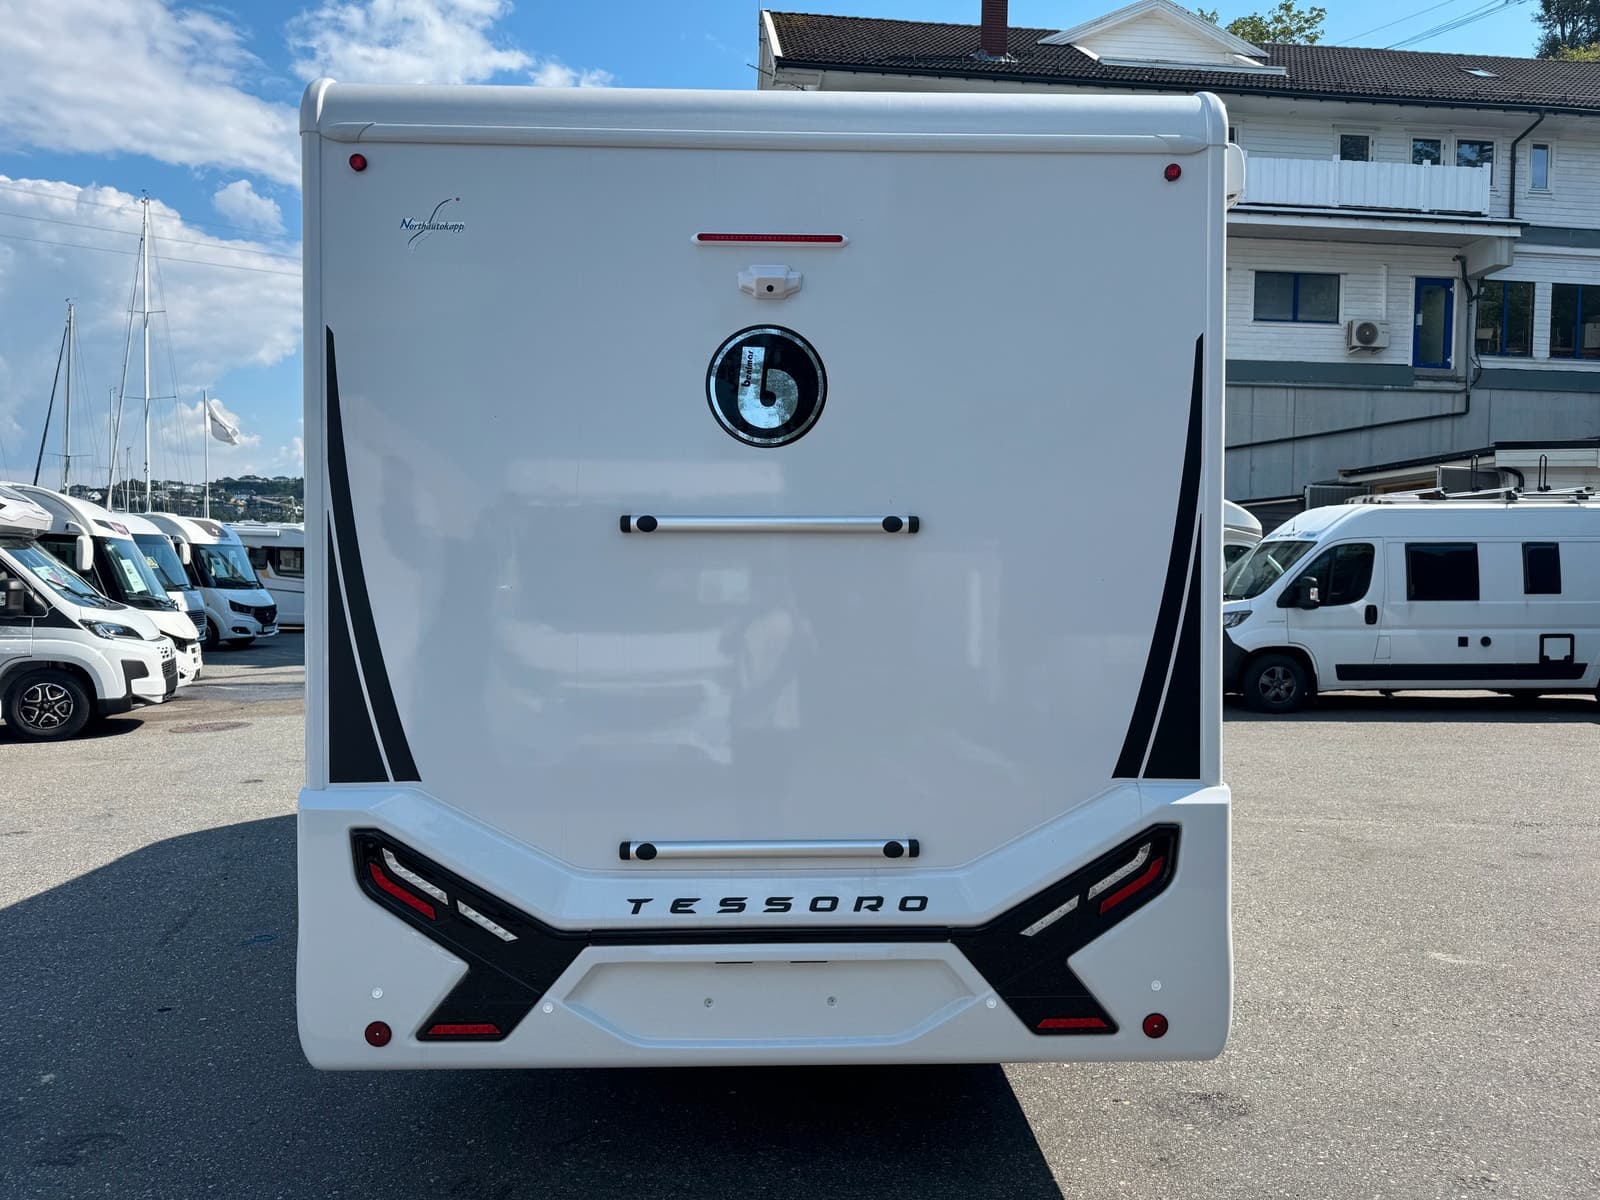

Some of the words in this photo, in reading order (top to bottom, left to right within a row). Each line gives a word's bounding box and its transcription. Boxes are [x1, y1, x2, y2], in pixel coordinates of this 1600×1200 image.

[400, 217, 465, 232] Northautokapp
[741, 350, 754, 387] benimar
[626, 896, 929, 914] TESSORO
